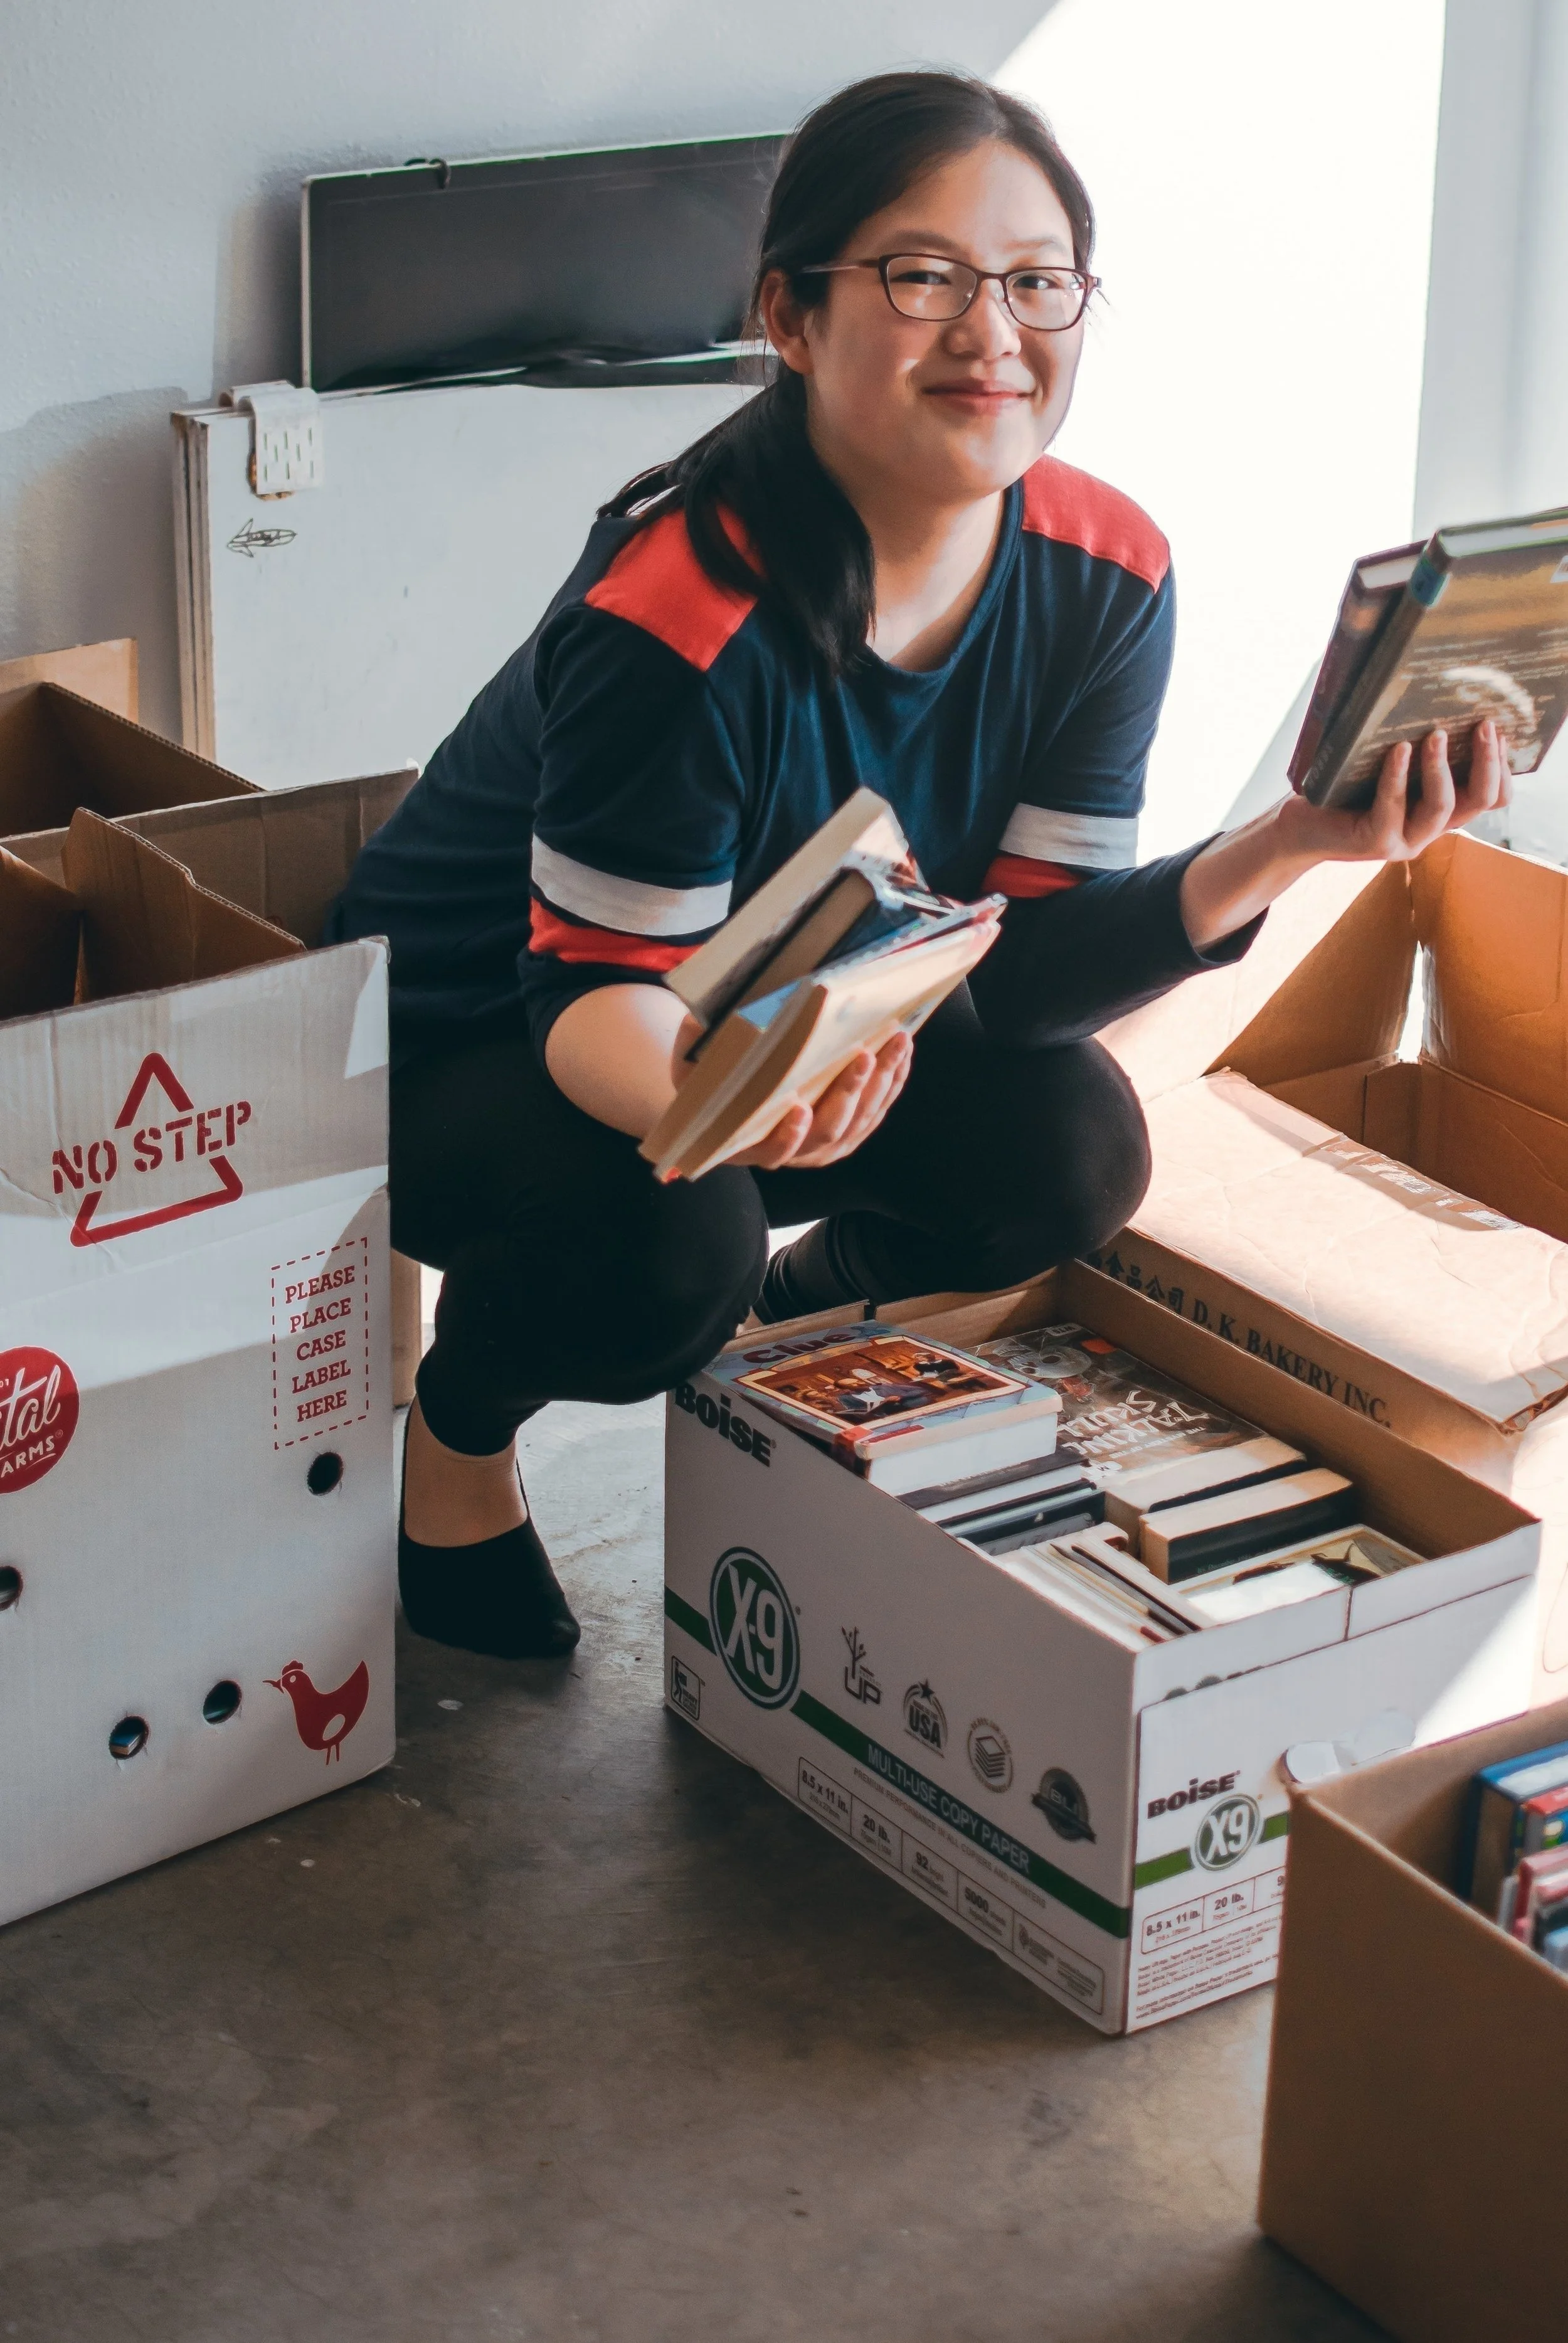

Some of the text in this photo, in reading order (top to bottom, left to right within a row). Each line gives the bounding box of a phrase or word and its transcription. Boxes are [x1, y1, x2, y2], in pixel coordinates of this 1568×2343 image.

[52, 1101, 252, 1194] NO STEP
[285, 1265, 356, 1305] PLEASE
[289, 1298, 352, 1333] PLACE
[296, 1330, 347, 1361] CASE
[743, 1331, 856, 1364] Clue
[292, 1361, 351, 1394] LABEL
[1194, 1298, 1392, 1428] D. K. BAKERY INC.
[0, 1364, 61, 1452] tal
[297, 1389, 348, 1423] HERE
[1056, 1389, 1157, 1437] SKULL
[1186, 1426, 1206, 1435] THE
[909, 1704, 941, 1750] USA
[802, 1770, 815, 1789] 8.5
[817, 1783, 824, 1796] x
[825, 1787, 835, 1805] 11
[863, 1814, 876, 1834] 20
[868, 1743, 937, 1809] MULTI-USE
[941, 1795, 978, 1836] COPY
[982, 1823, 1030, 1874] PAPER
[916, 1852, 929, 1870] 92
[1277, 1875, 1285, 1886] 9
[965, 1886, 989, 1913] 5000
[1214, 1896, 1228, 1911] 20
[1147, 1920, 1163, 1937] 8.5
[1166, 1920, 1172, 1929] x
[1175, 1911, 1188, 1925] 11
